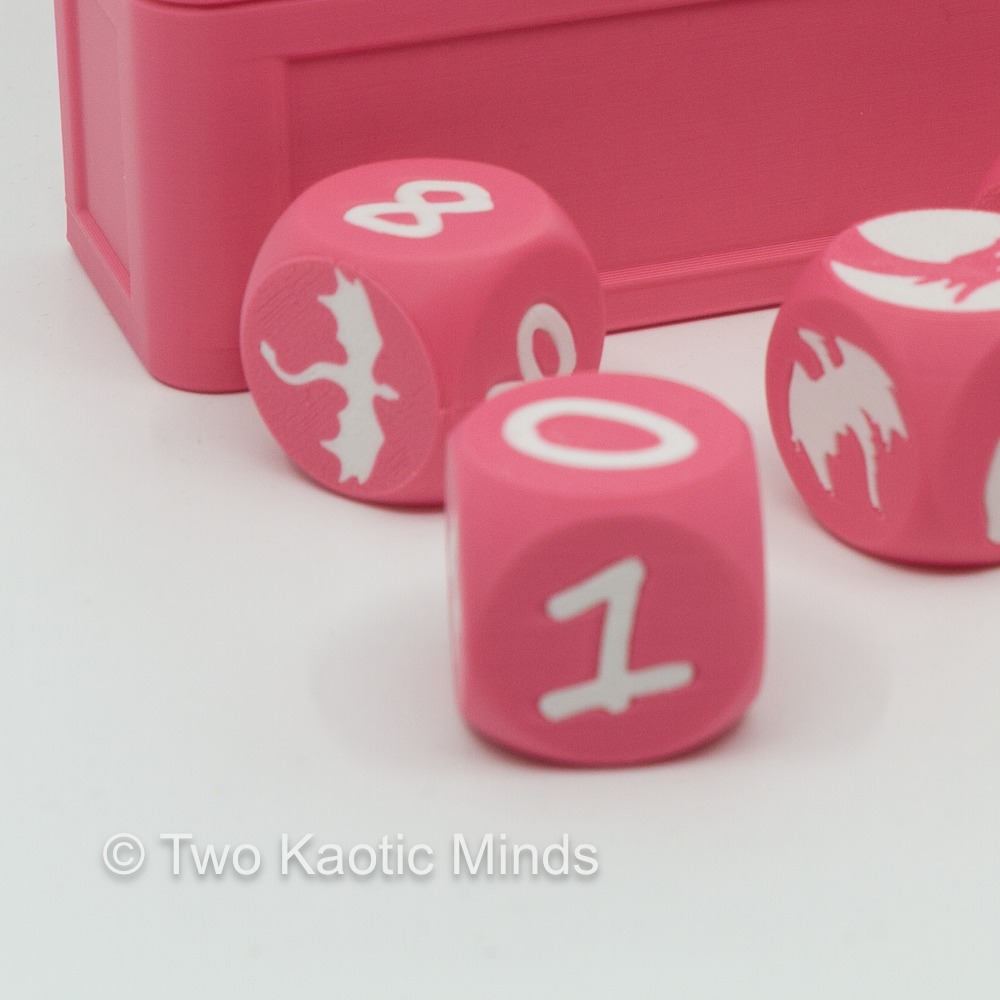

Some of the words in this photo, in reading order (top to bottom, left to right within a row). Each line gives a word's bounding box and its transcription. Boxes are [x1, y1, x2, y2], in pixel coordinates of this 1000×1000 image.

[343, 179, 495, 239] 8
[502, 397, 698, 470] 0
[538, 557, 694, 722] 1
